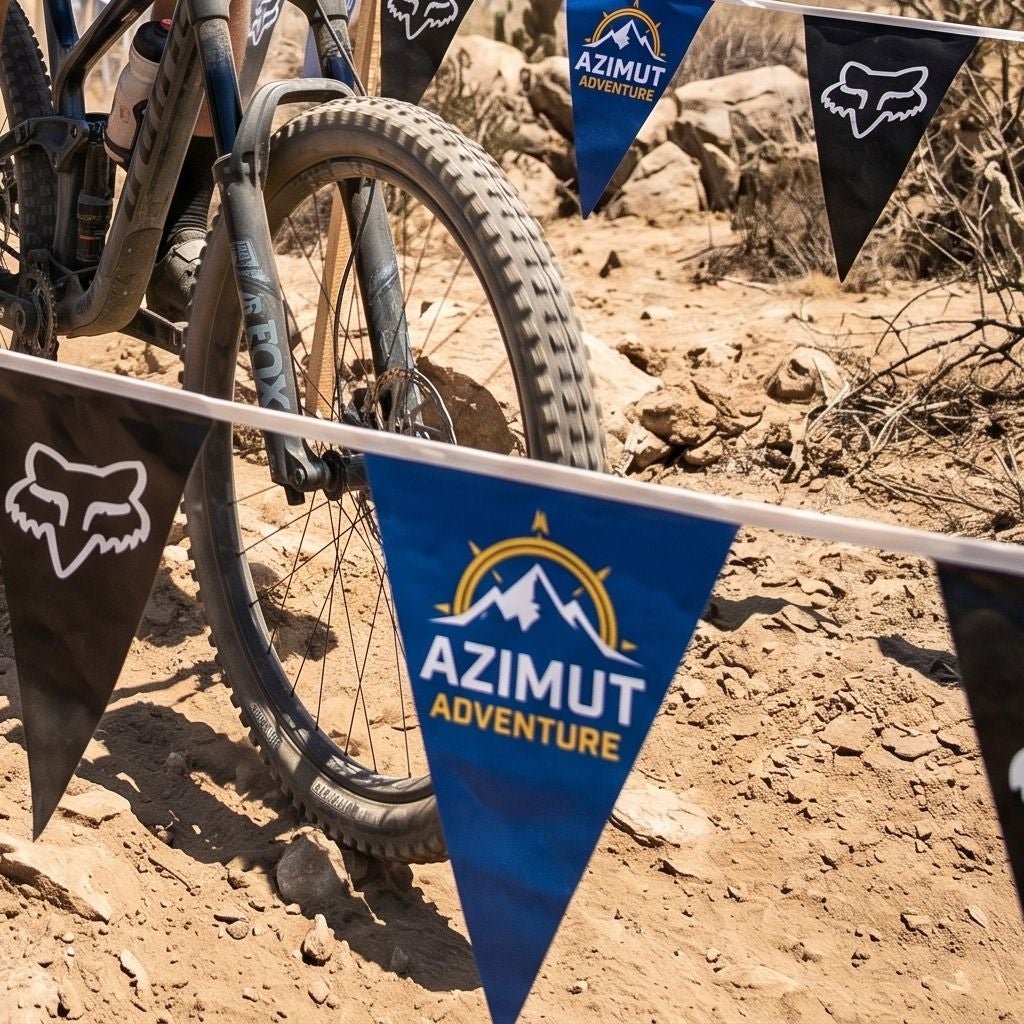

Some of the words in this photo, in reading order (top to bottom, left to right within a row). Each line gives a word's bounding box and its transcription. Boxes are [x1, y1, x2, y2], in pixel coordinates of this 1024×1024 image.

[575, 51, 667, 87] AZIMUT
[579, 75, 655, 102] ADVENTURE
[246, 319, 292, 411] FOX
[419, 635, 646, 727] AZIMUT
[430, 693, 622, 762] ADVENTURE
